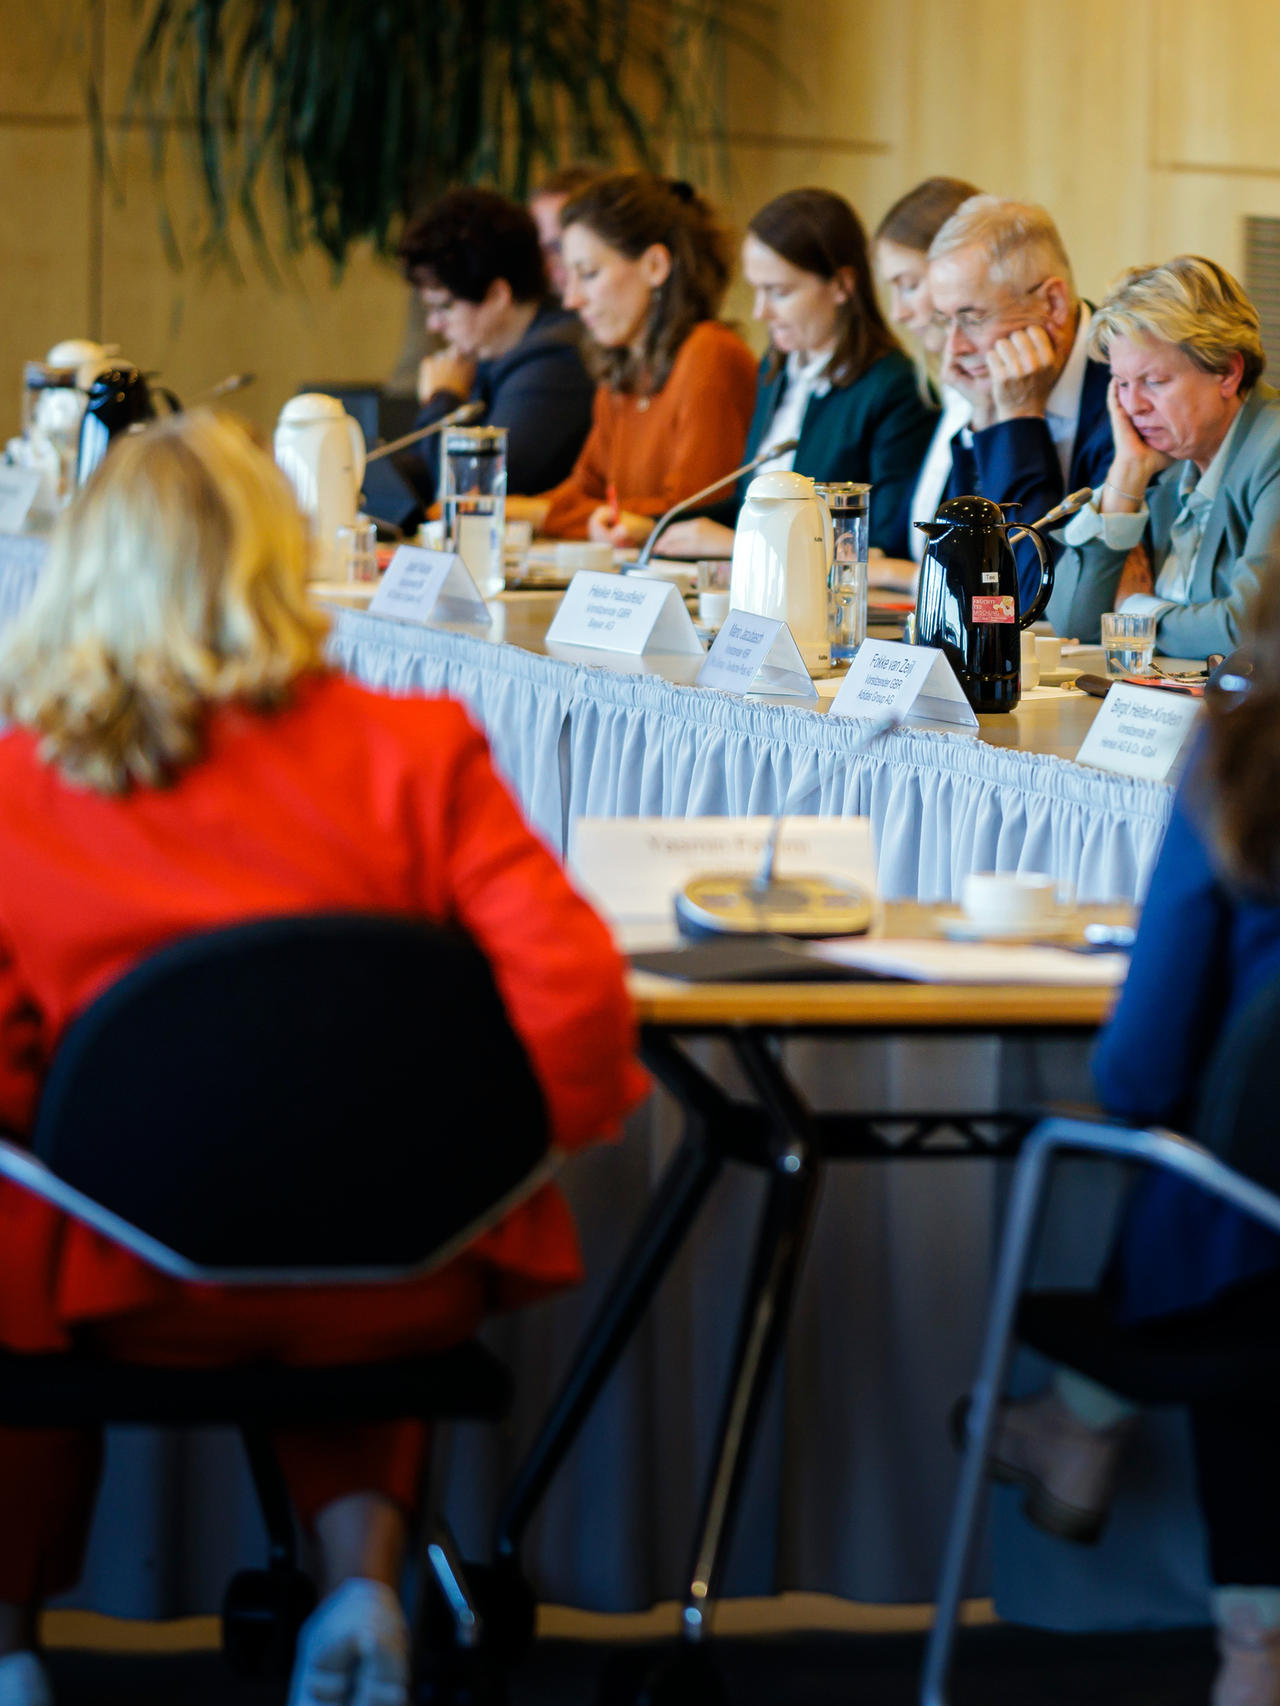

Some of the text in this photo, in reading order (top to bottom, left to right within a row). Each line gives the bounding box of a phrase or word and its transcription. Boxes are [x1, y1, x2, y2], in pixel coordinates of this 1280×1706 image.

[869, 653, 890, 670] Fokke
[889, 659, 901, 672] van
[871, 691, 886, 705] Group
[885, 694, 896, 705] AG
